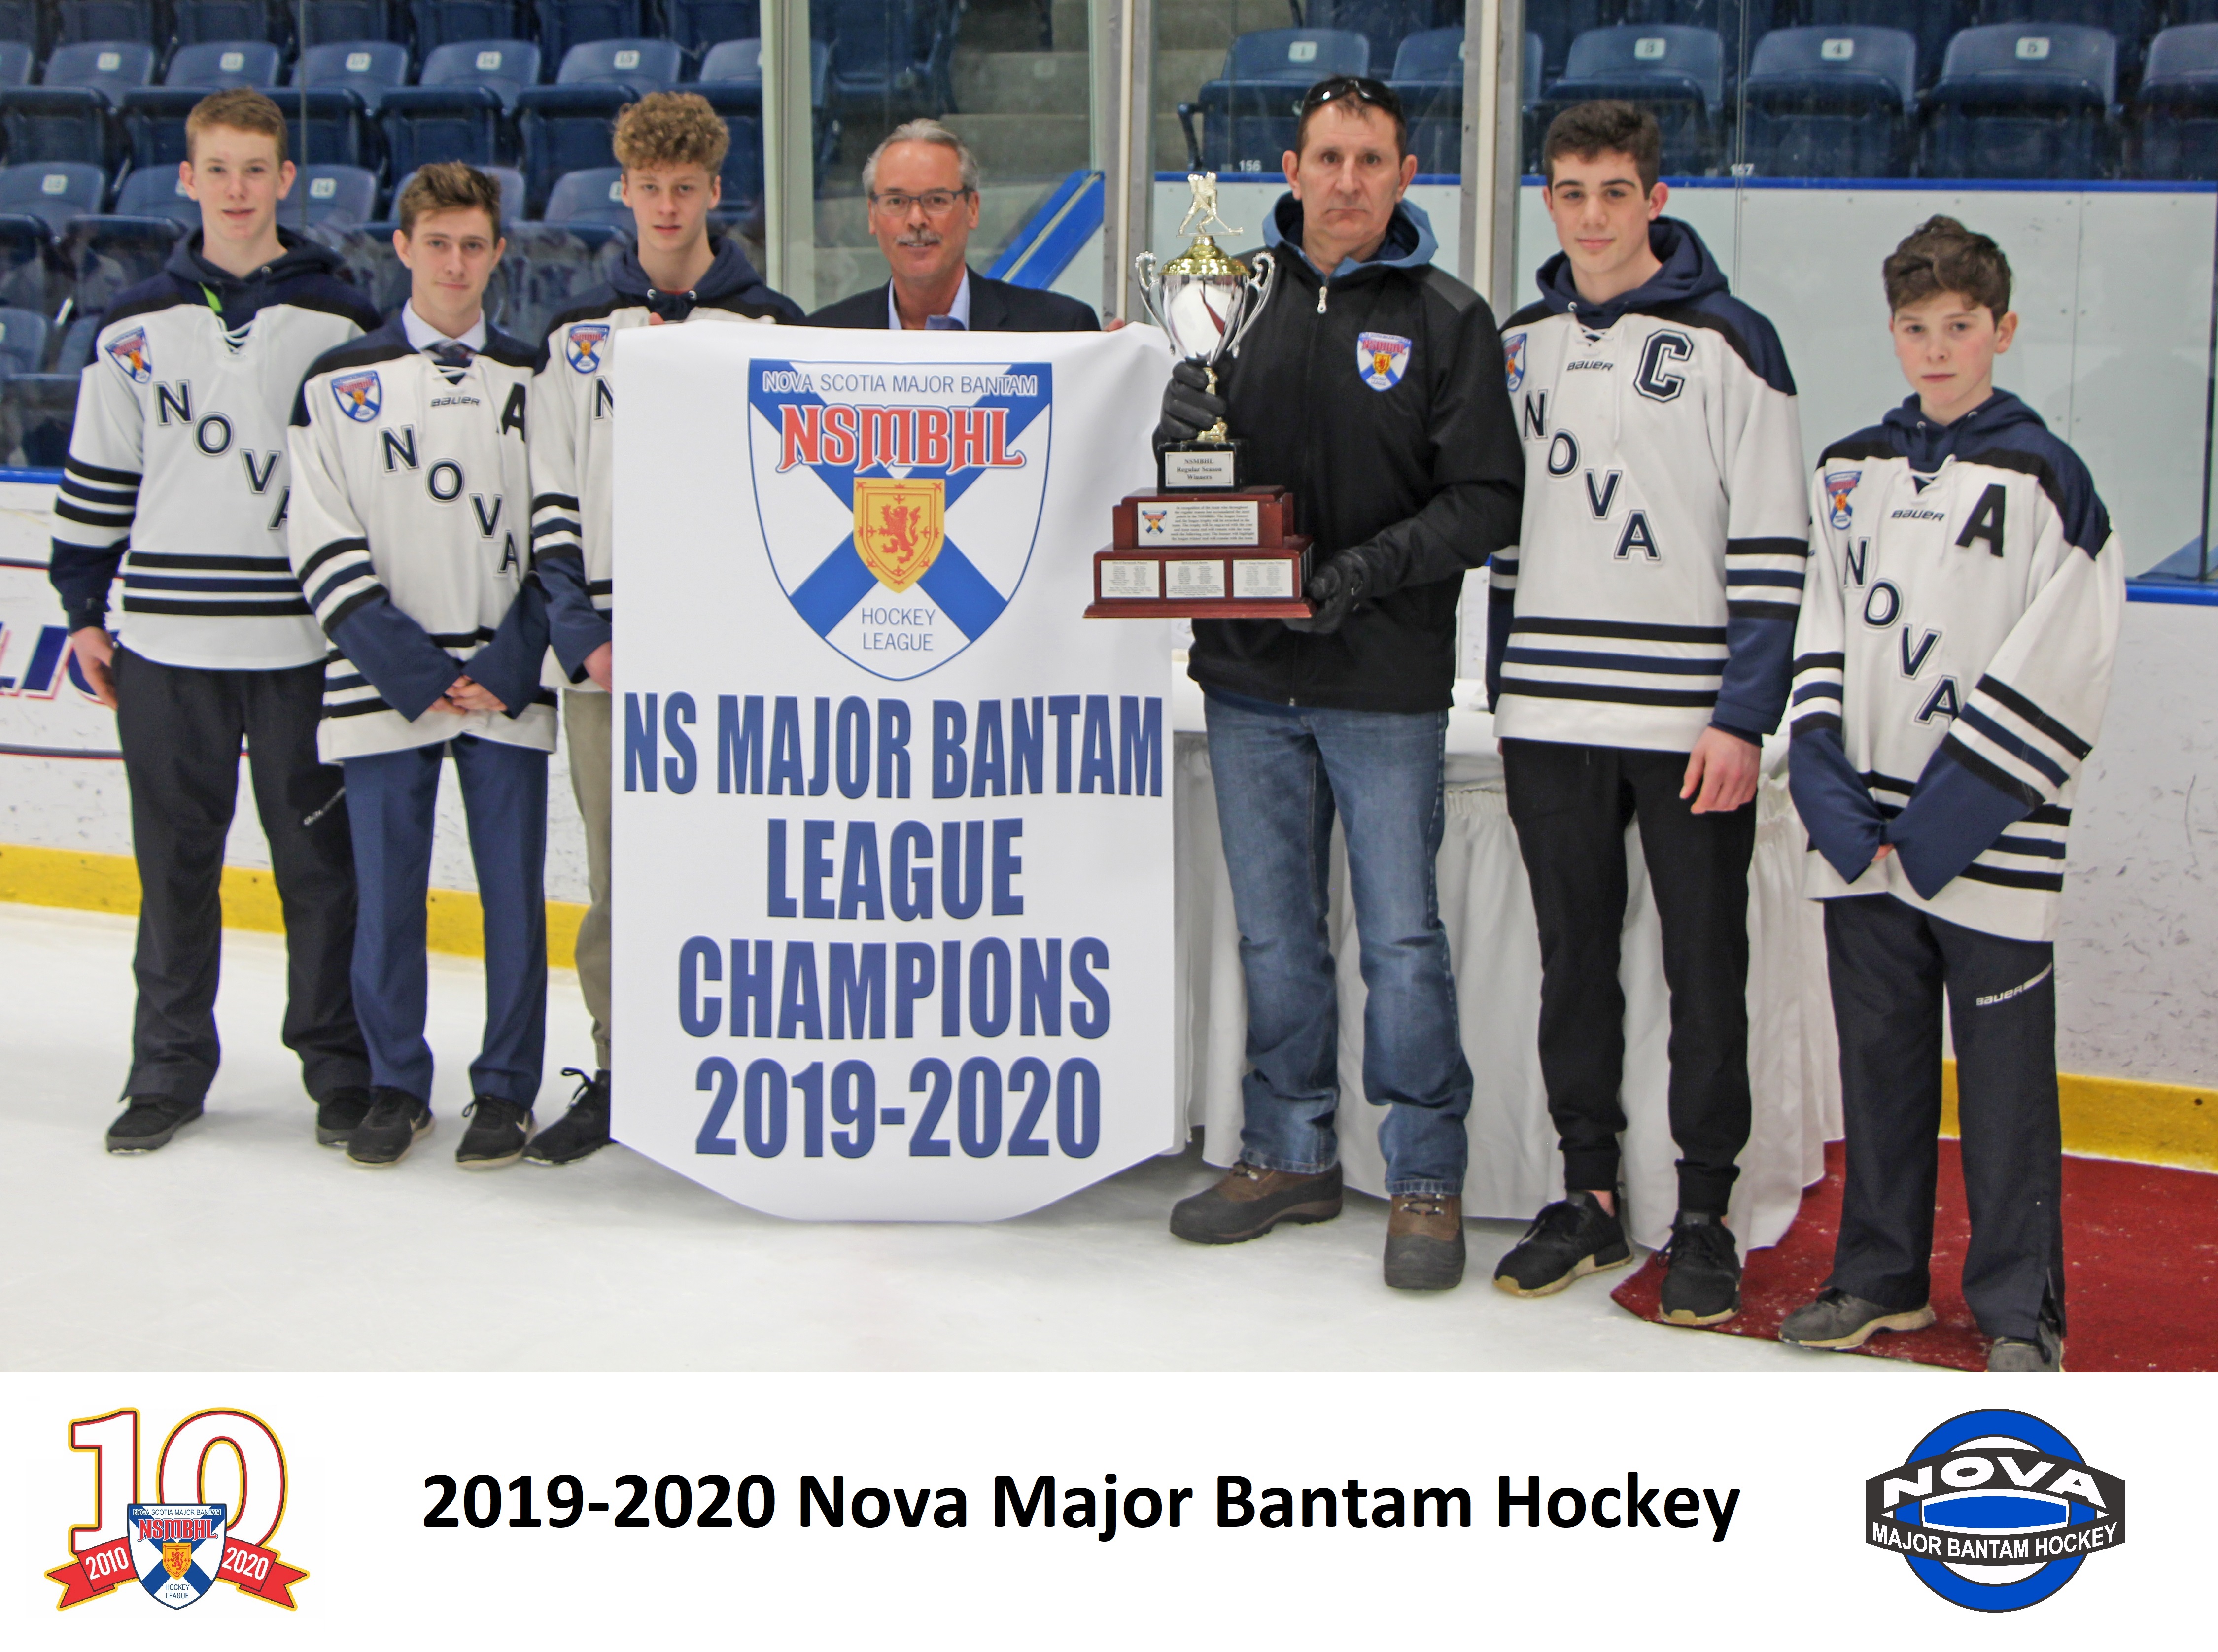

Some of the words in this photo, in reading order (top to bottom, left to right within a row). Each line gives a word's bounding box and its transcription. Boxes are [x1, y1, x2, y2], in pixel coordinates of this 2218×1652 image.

[1239, 159, 1261, 172] 156
[762, 370, 815, 393] NOVA
[820, 373, 887, 393] SCOTIA
[892, 374, 954, 394] MAJOR
[960, 374, 1038, 395] BANTAM
[1633, 328, 1693, 402] C
[776, 404, 1027, 476] NSMBHL
[1525, 389, 1661, 561] NOVA
[379, 424, 520, 573] NOVA
[1955, 483, 2006, 557] A
[861, 607, 936, 626] HOCKEY
[862, 633, 934, 651] LEAGUE
[1844, 537, 1965, 724] NOVA
[624, 691, 697, 794] NS
[717, 694, 911, 799] MAJOR
[931, 694, 1163, 799] BANTAM
[767, 817, 1024, 922] LEAGUE
[678, 935, 1110, 1039] CHAMPIONS
[695, 1055, 1101, 1158] 2019-2020
